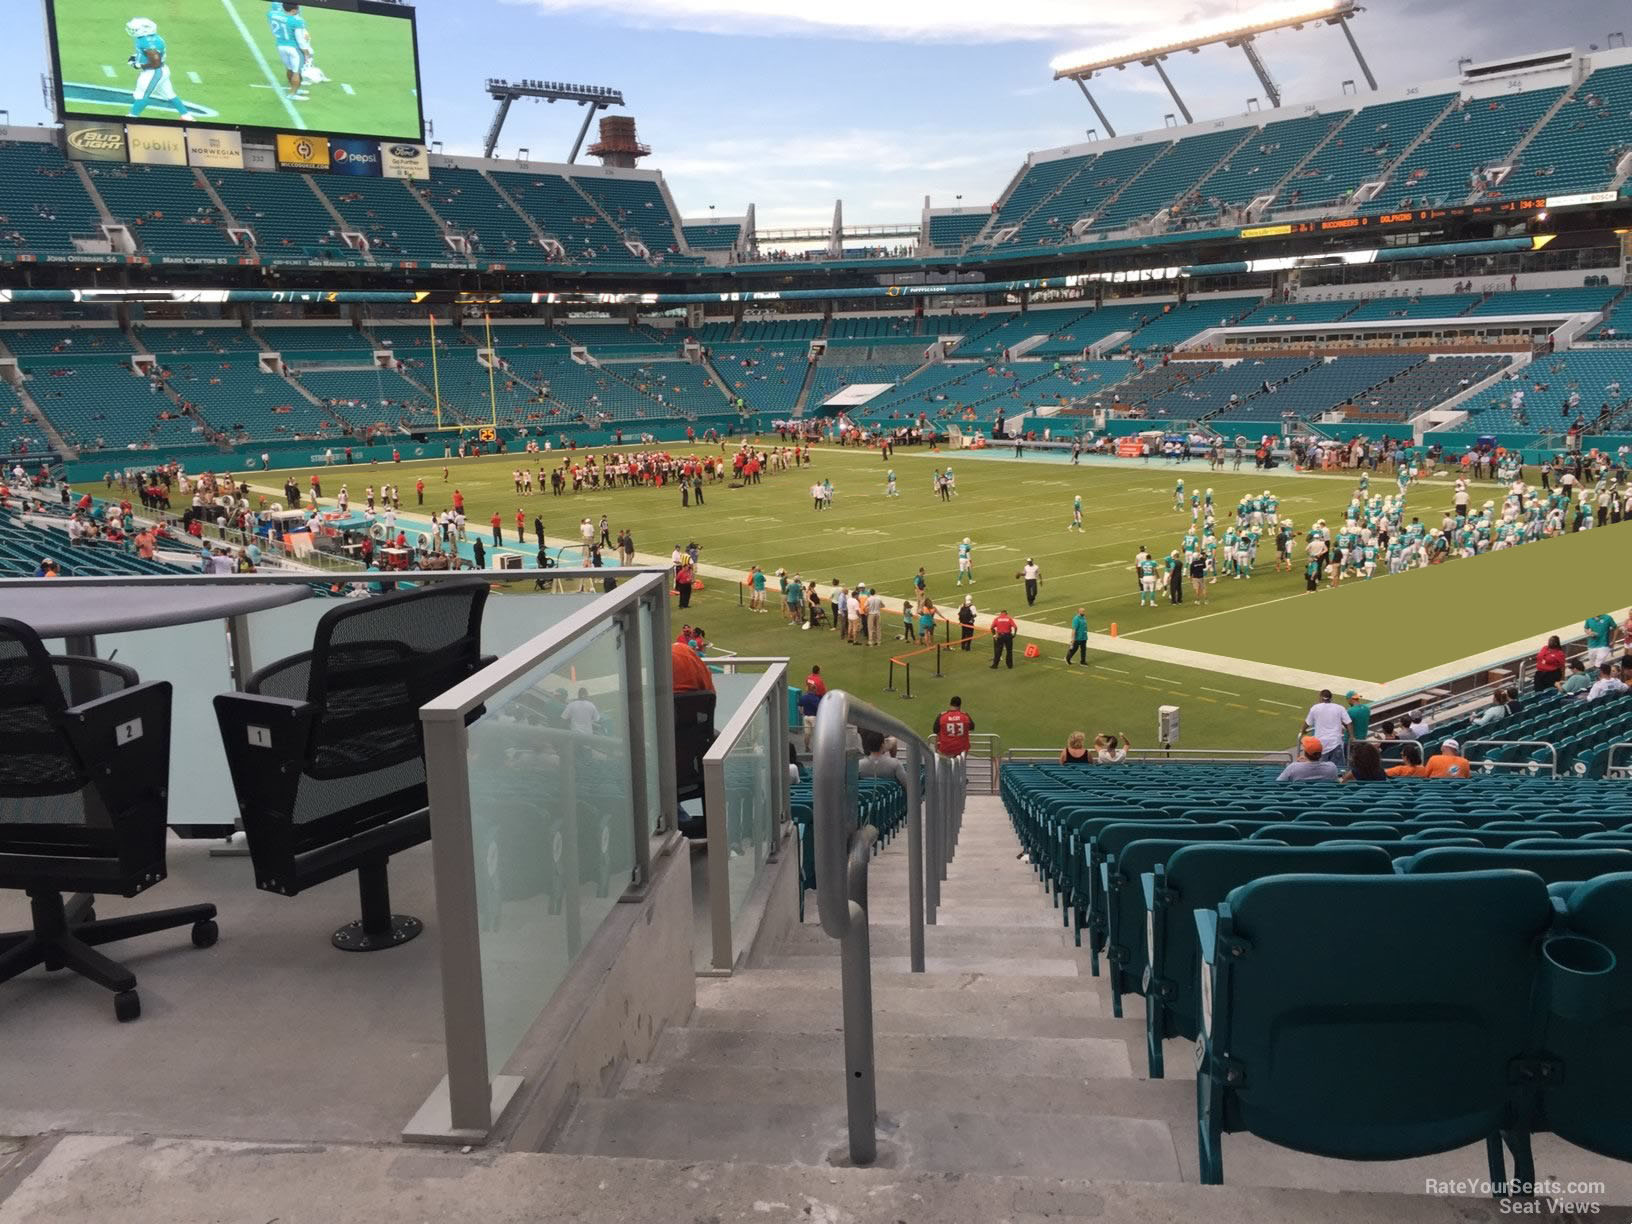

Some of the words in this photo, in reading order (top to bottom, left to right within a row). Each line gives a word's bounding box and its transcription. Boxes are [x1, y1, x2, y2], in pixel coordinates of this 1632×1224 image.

[271, 20, 290, 40] 21
[83, 132, 121, 141] BUD
[78, 140, 124, 149] LIGHT
[132, 139, 179, 151] Publix
[394, 146, 415, 157] Ford
[349, 153, 377, 164] pepsi
[1380, 213, 1412, 224] DOLPHINS
[481, 428, 495, 440] 25
[126, 725, 133, 738] 2
[946, 722, 964, 736] 93
[257, 730, 262, 743] 1
